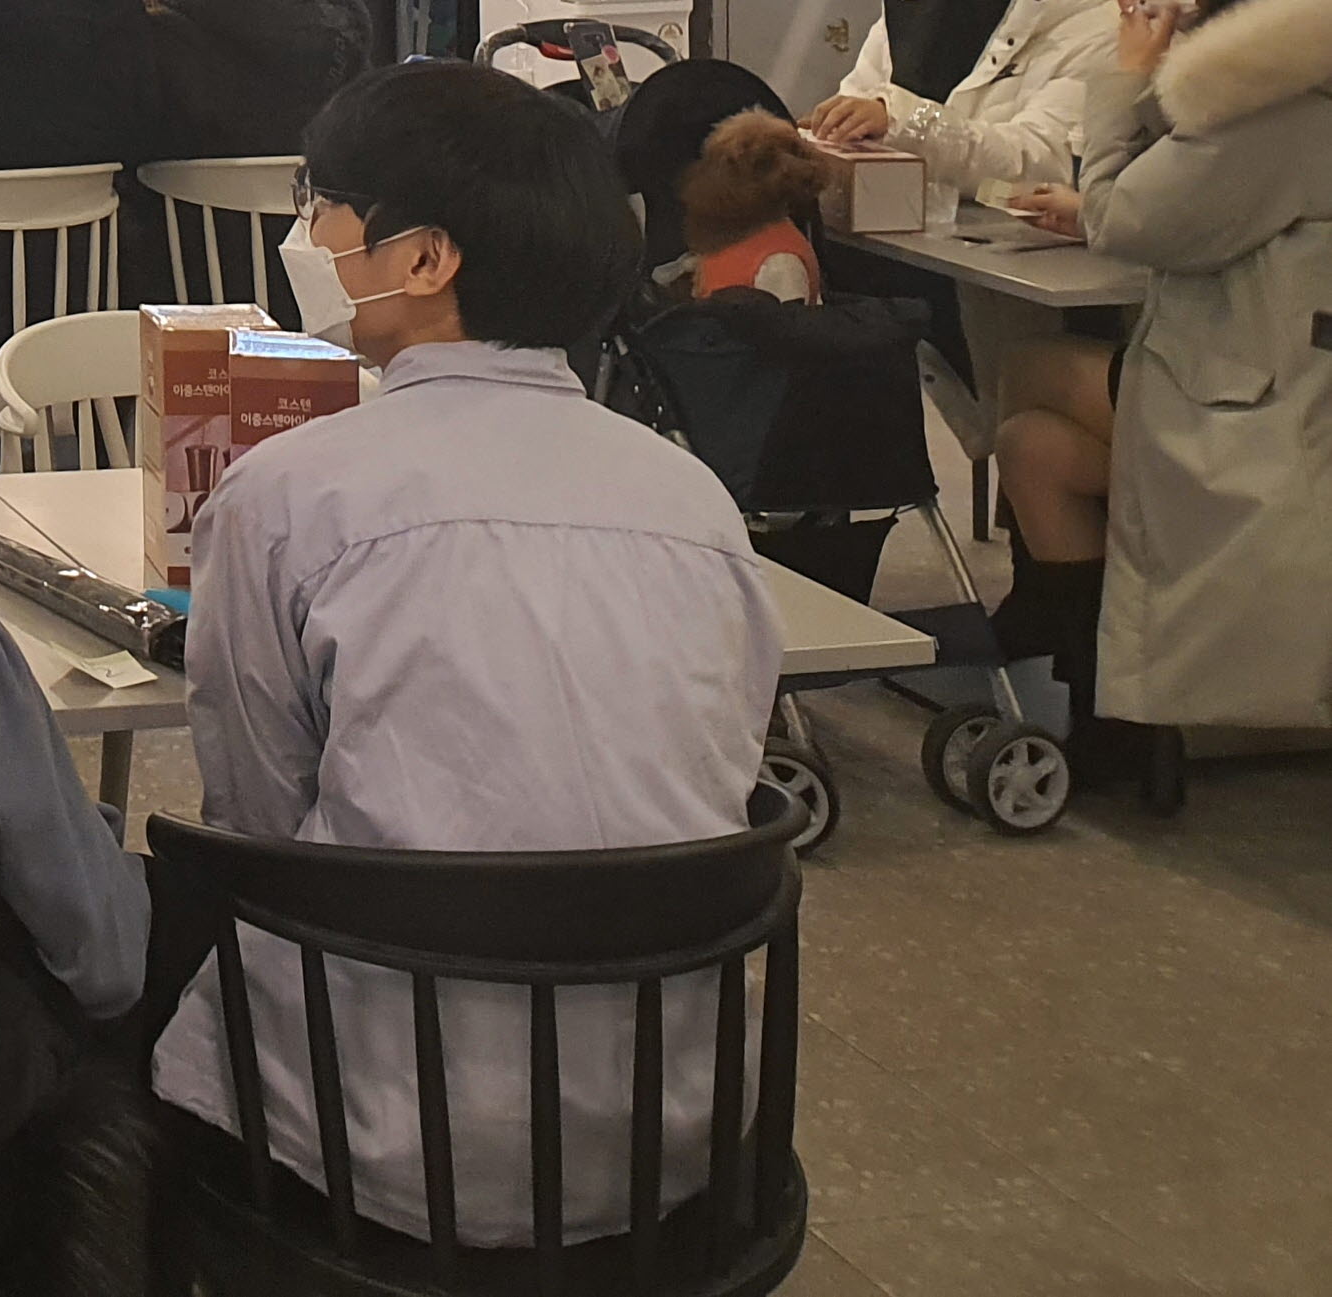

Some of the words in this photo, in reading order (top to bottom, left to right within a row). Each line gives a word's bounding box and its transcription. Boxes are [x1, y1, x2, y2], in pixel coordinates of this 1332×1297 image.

[208, 368, 230, 380] 코스
[278, 398, 312, 411] 코스텐
[241, 413, 315, 428] 이중스텐아이
